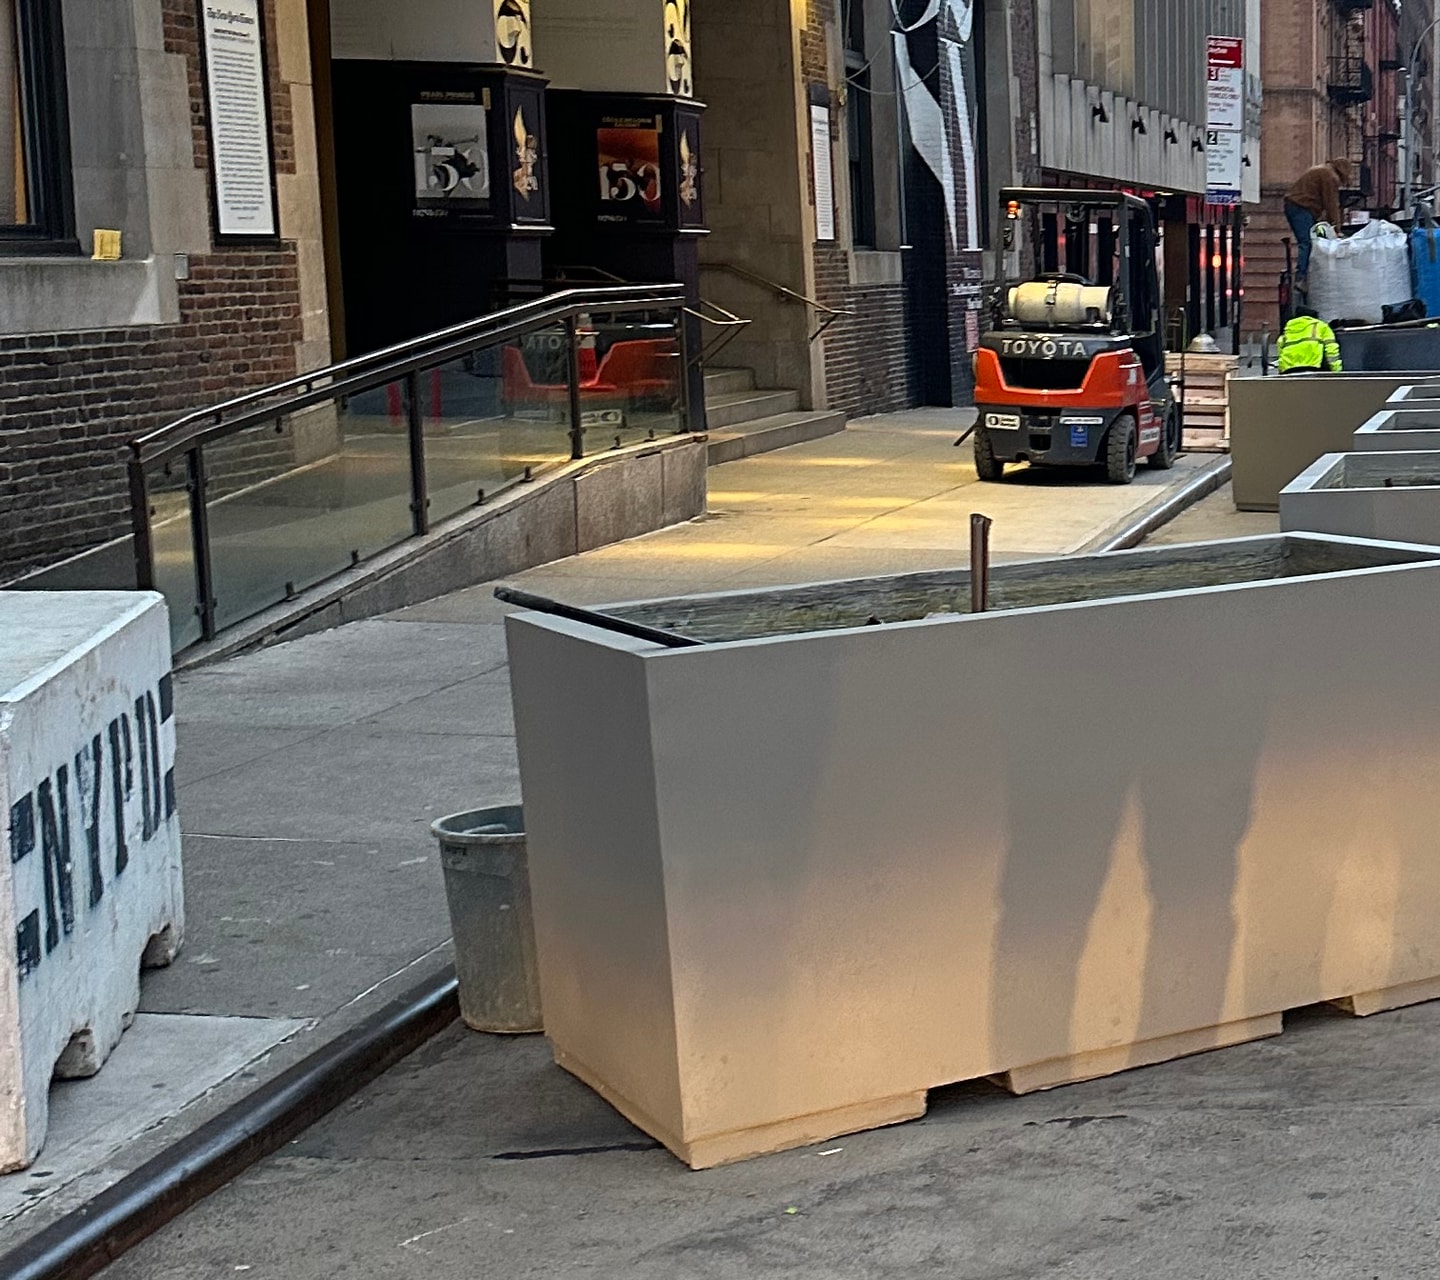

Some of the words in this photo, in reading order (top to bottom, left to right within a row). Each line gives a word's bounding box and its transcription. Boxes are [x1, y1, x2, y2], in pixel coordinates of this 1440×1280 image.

[599, 162, 661, 201] 150
[1002, 339, 1087, 357] TOYOTA
[38, 689, 162, 957] NYPD
